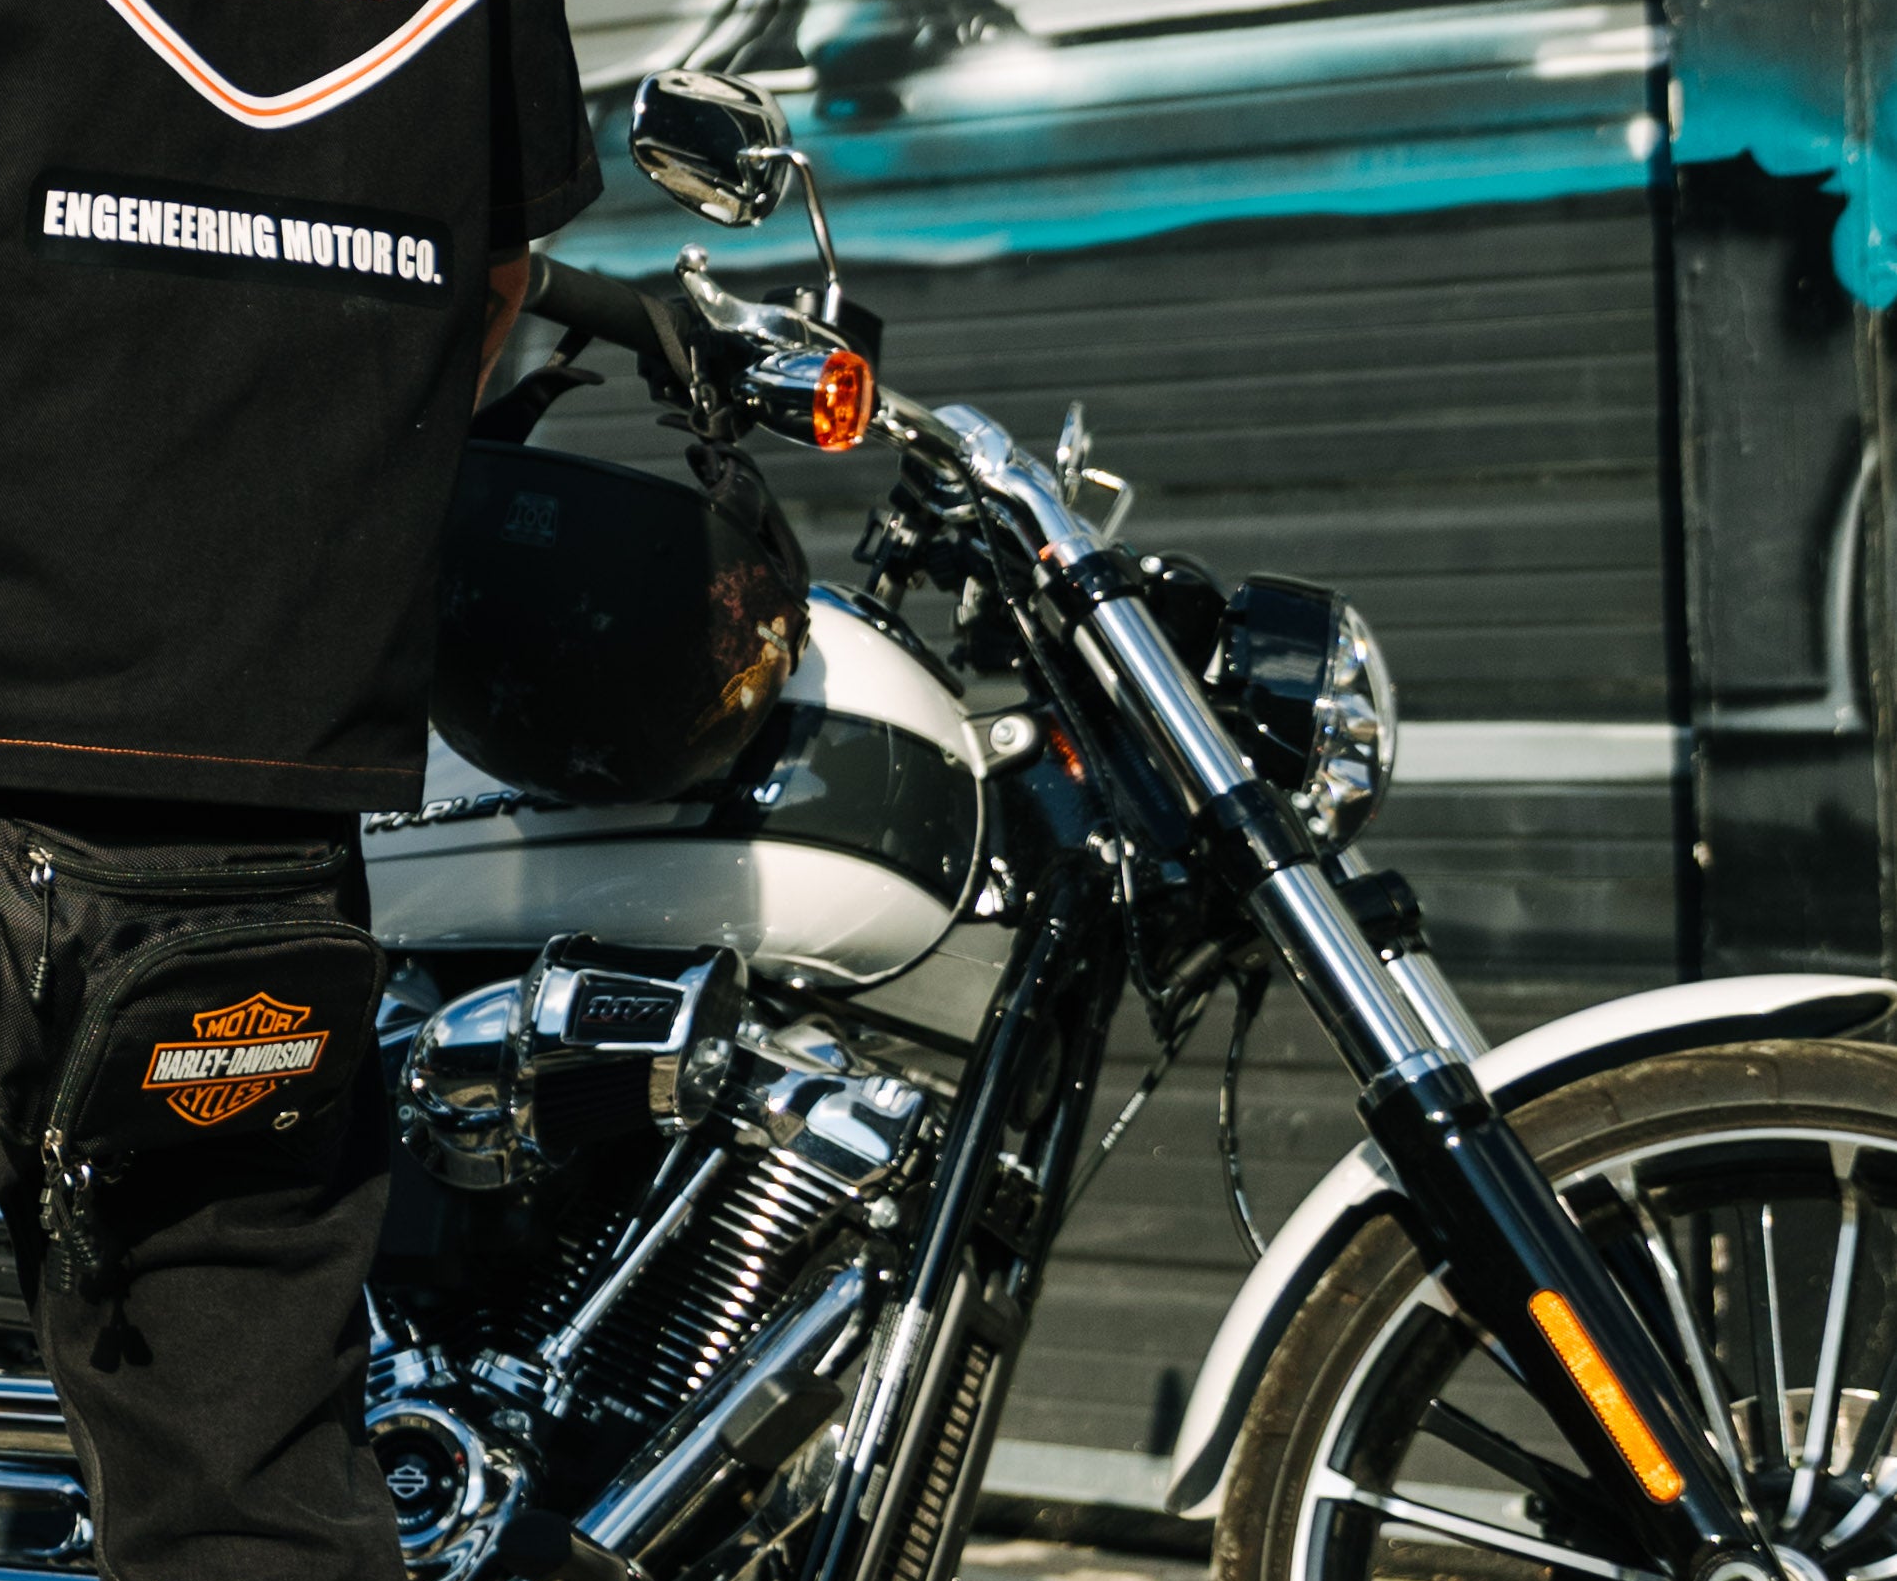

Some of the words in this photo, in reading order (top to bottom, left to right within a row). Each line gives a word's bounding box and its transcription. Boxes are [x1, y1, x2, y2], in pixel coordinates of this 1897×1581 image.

[43, 189, 279, 259] ENGENEERING
[280, 218, 393, 276] MOTOR
[397, 235, 443, 285] CO.
[205, 1001, 293, 1038] MOTOR
[153, 1038, 320, 1082] HARLEY-DAVIDSON
[178, 1080, 269, 1118] CYCLES
